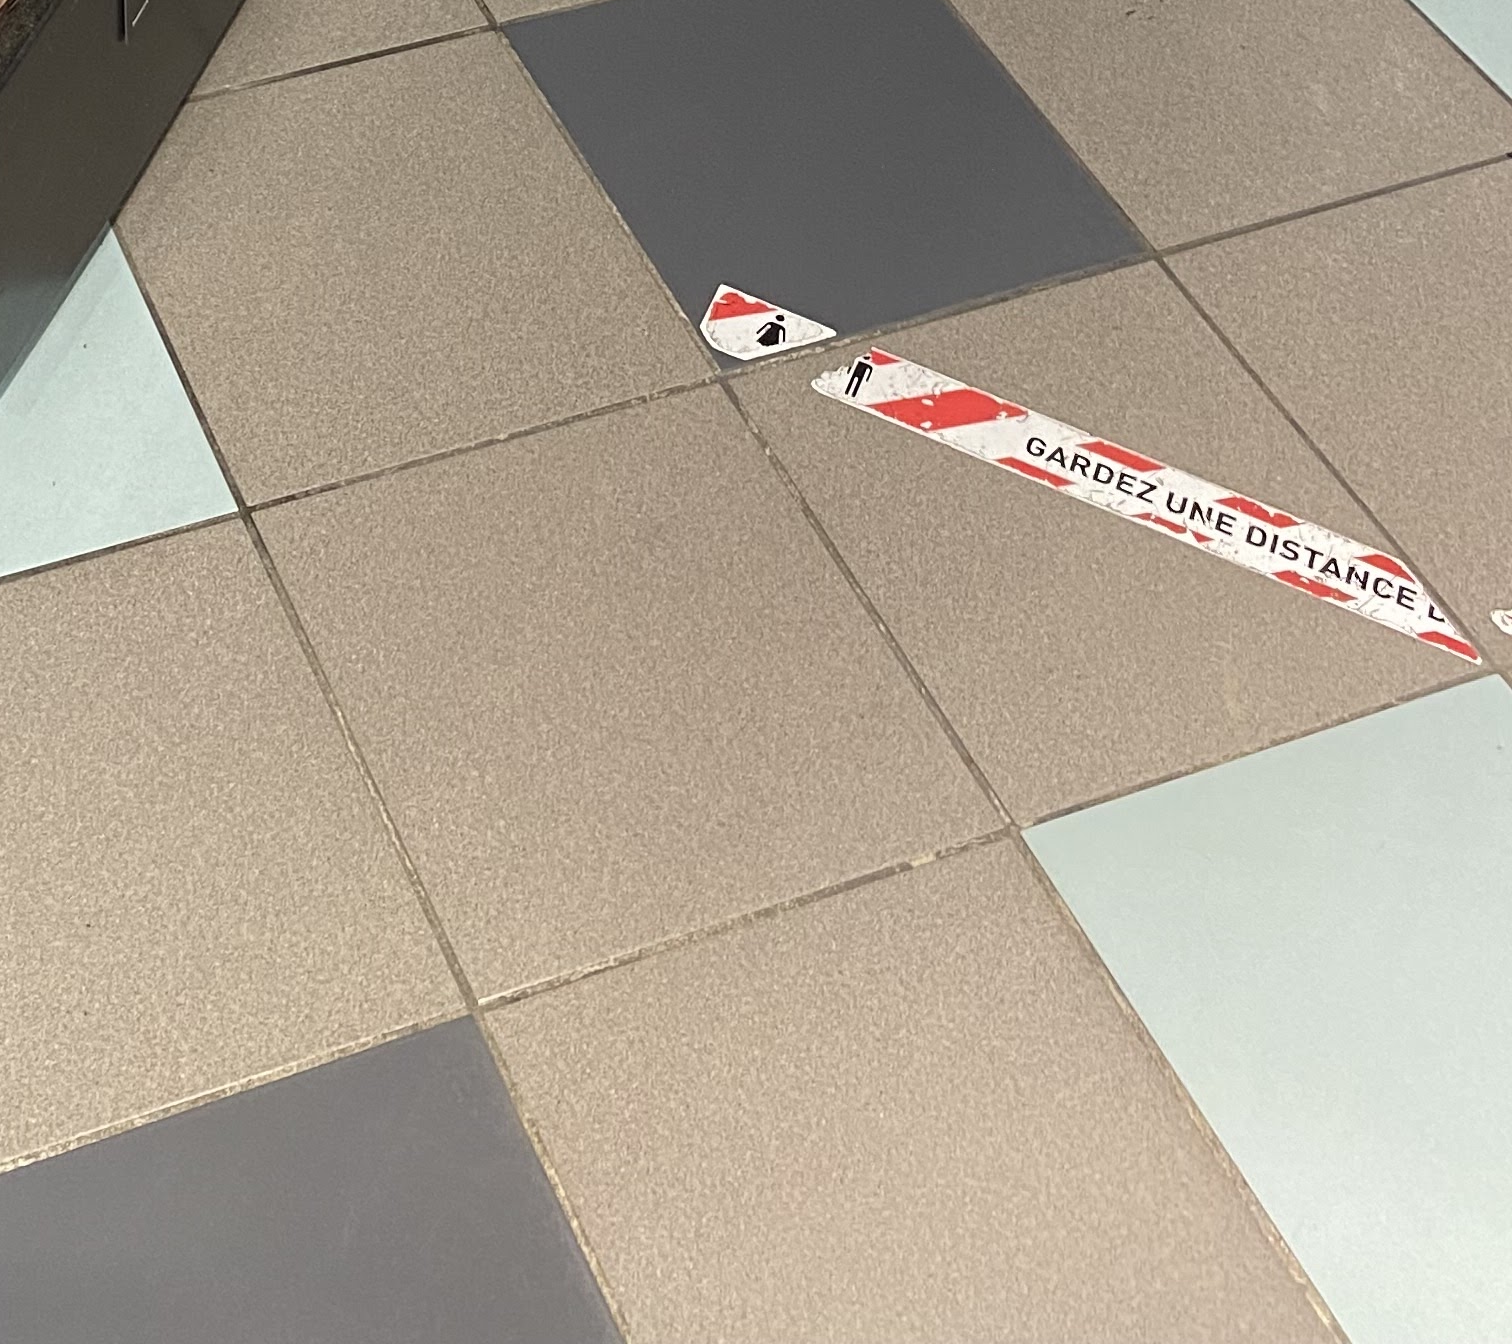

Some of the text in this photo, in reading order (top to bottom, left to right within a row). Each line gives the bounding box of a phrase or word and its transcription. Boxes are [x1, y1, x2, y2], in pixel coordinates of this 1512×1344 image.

[1025, 435, 1419, 611] GARDEZ UNE DISTANCE
